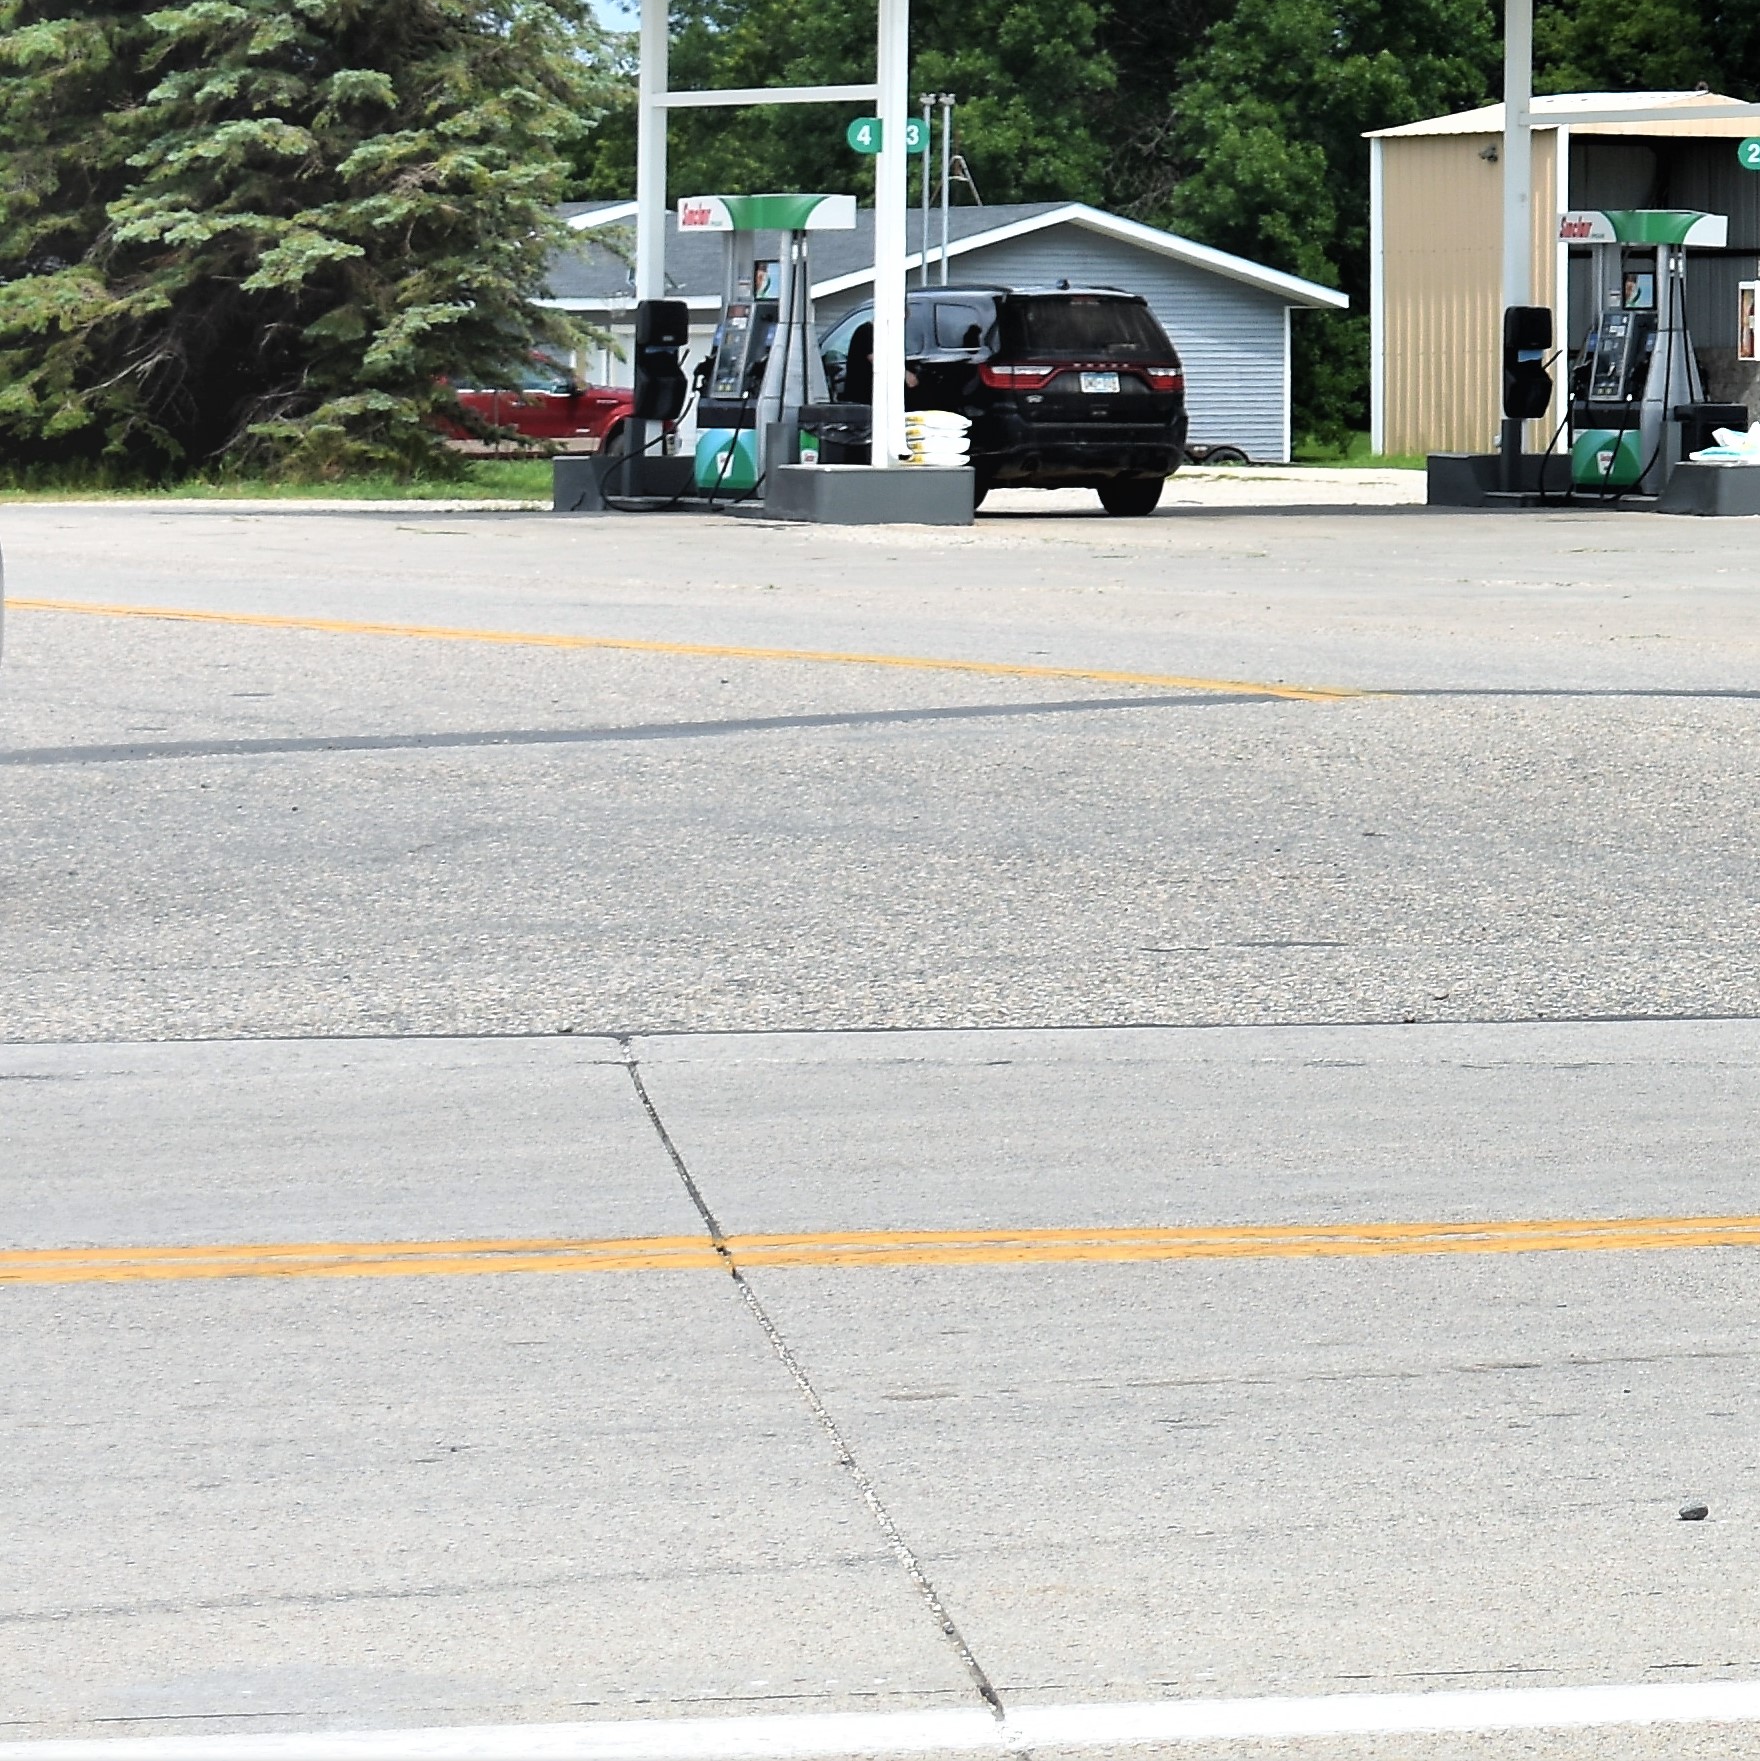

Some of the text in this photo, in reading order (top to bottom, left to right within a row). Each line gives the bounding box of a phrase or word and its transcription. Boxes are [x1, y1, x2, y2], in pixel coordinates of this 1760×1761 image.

[856, 124, 872, 146] 4
[905, 124, 919, 146] 3
[1747, 143, 1760, 163] 2
